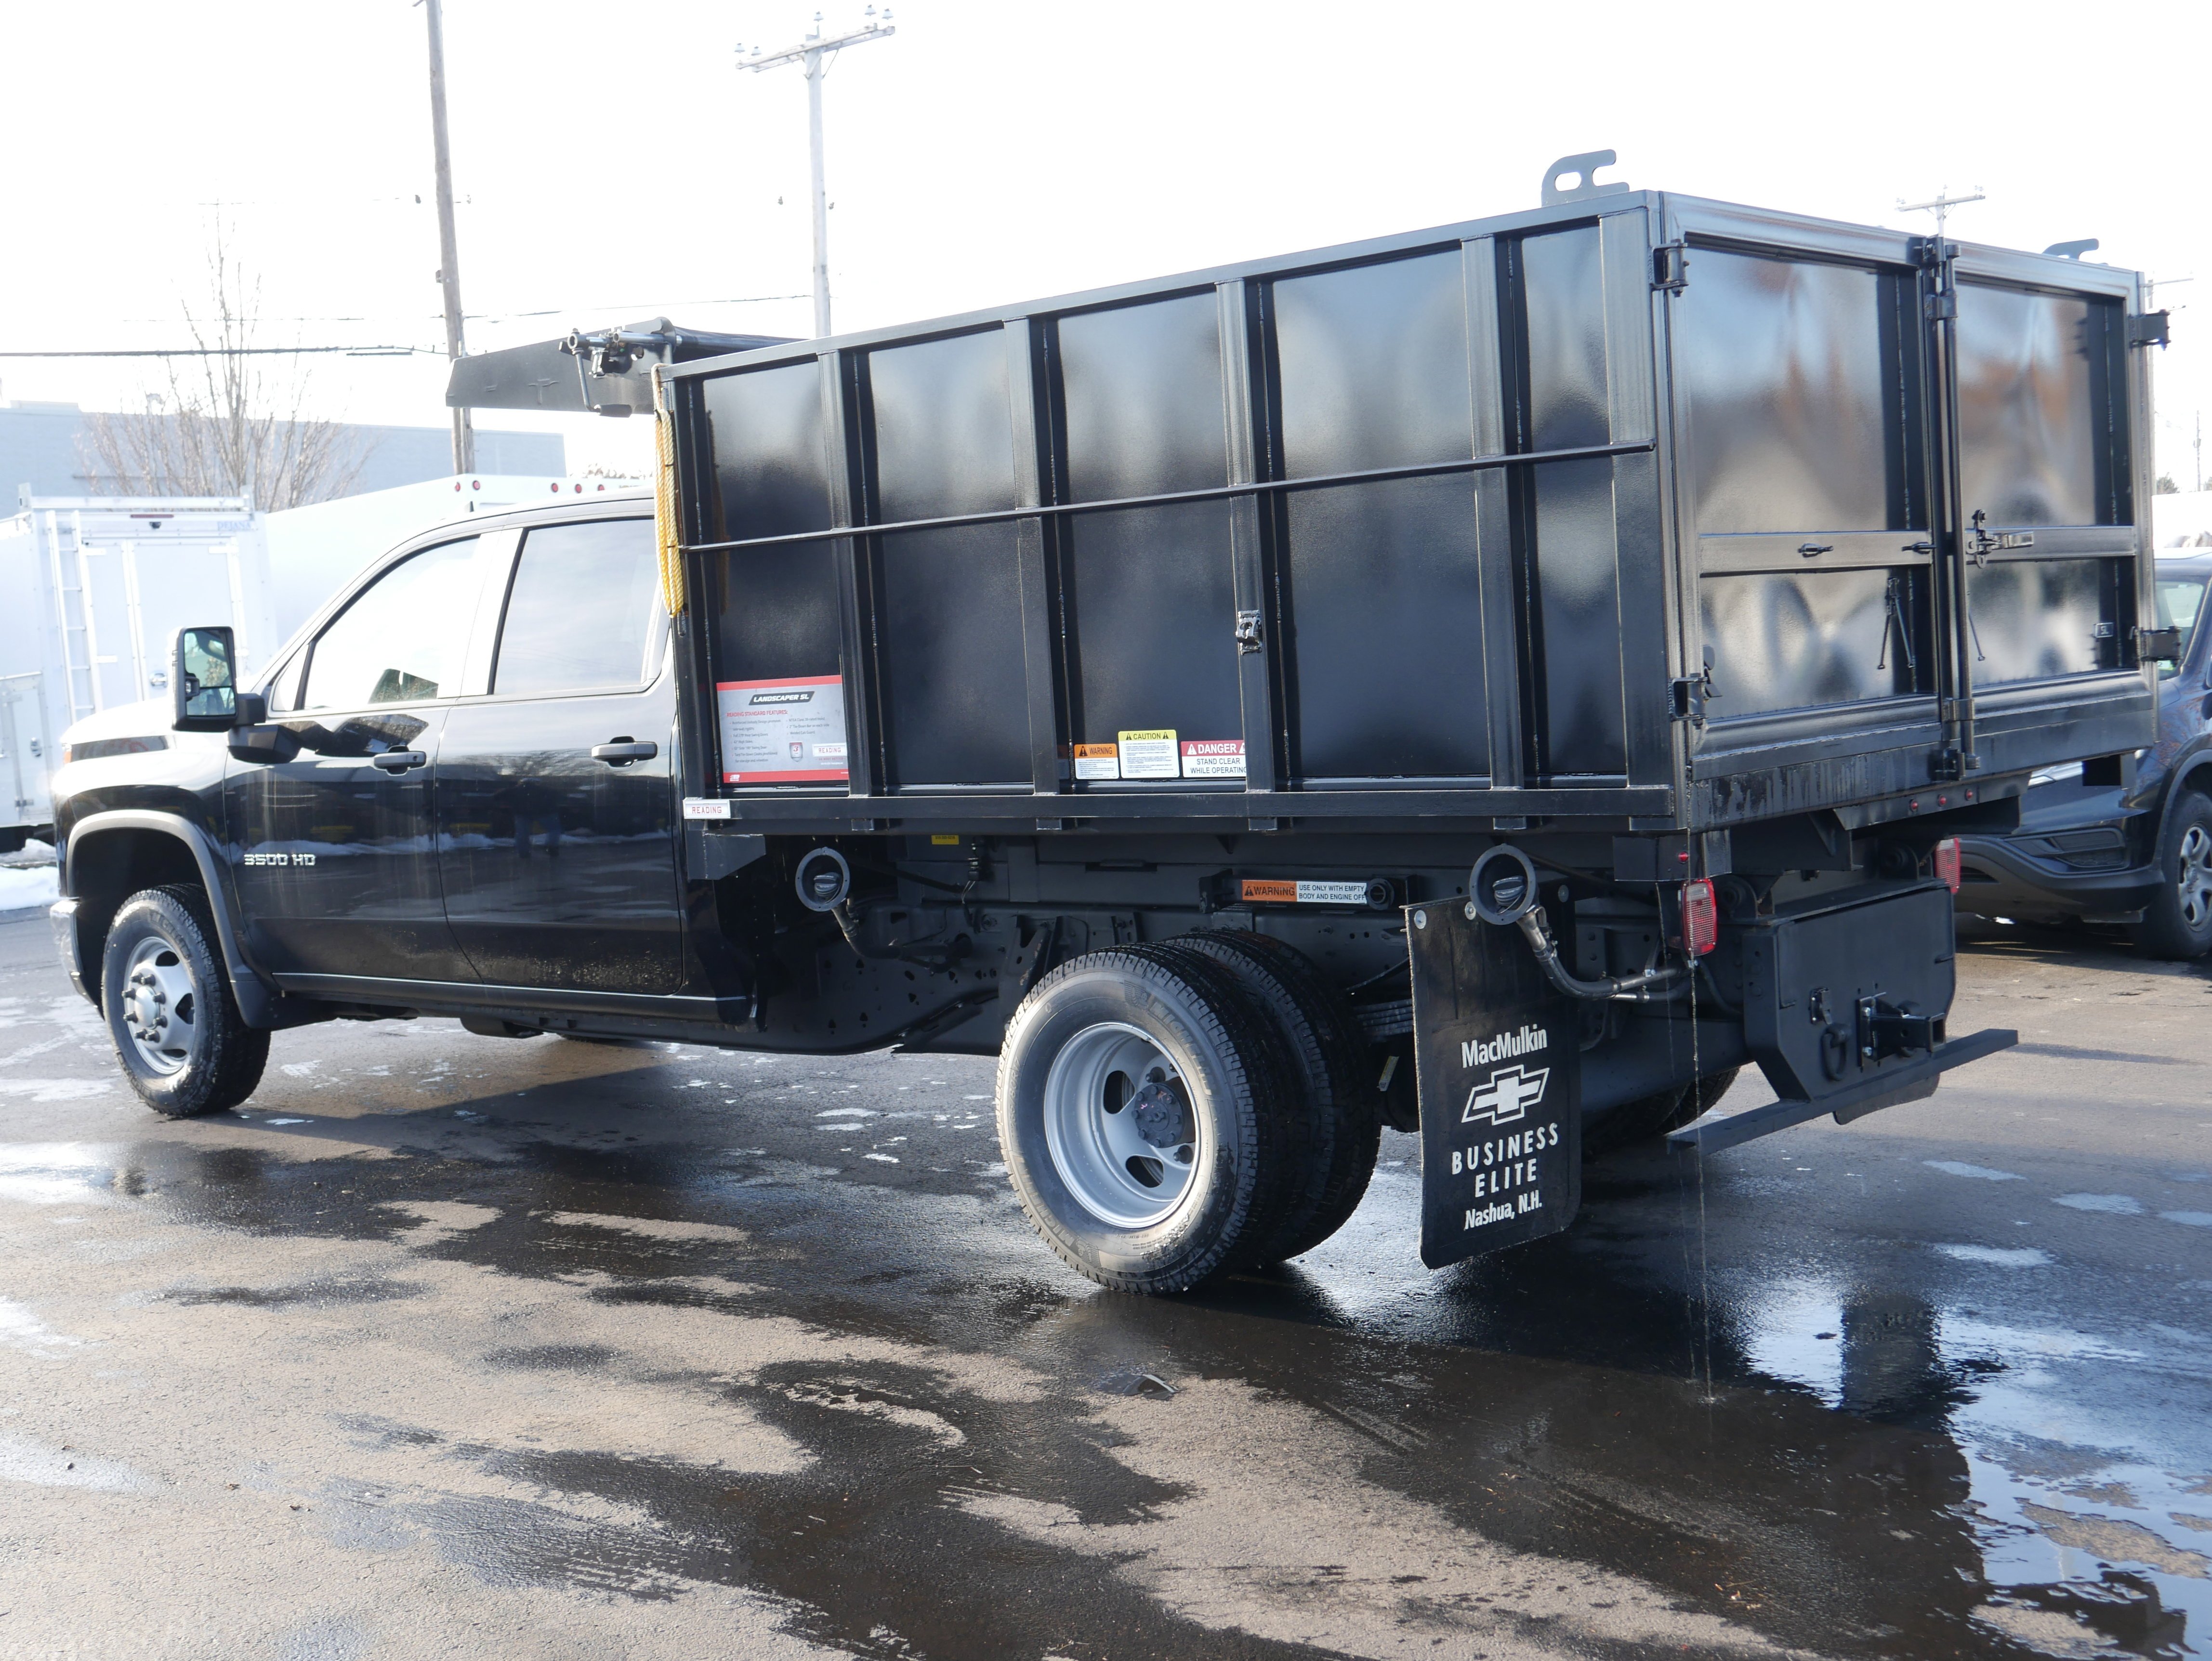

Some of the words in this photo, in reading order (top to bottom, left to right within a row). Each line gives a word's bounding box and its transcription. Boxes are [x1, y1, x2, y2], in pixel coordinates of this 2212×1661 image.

[753, 694, 799, 702] LANDSCAPER
[1089, 747, 1113, 755] WARNING
[1198, 743, 1237, 754] DANGER
[244, 853, 289, 866] 3500
[291, 854, 316, 866] HD
[1253, 886, 1295, 896] WARNING
[1150, 1001, 1217, 1095] MICHELIN
[1461, 1024, 1548, 1068] MacMulkin
[1451, 1122, 1558, 1175] BUSINESS
[1475, 1159, 1537, 1198] ELITE
[1464, 1202, 1515, 1231] Nashua,
[1518, 1190, 1542, 1215] N.H.
